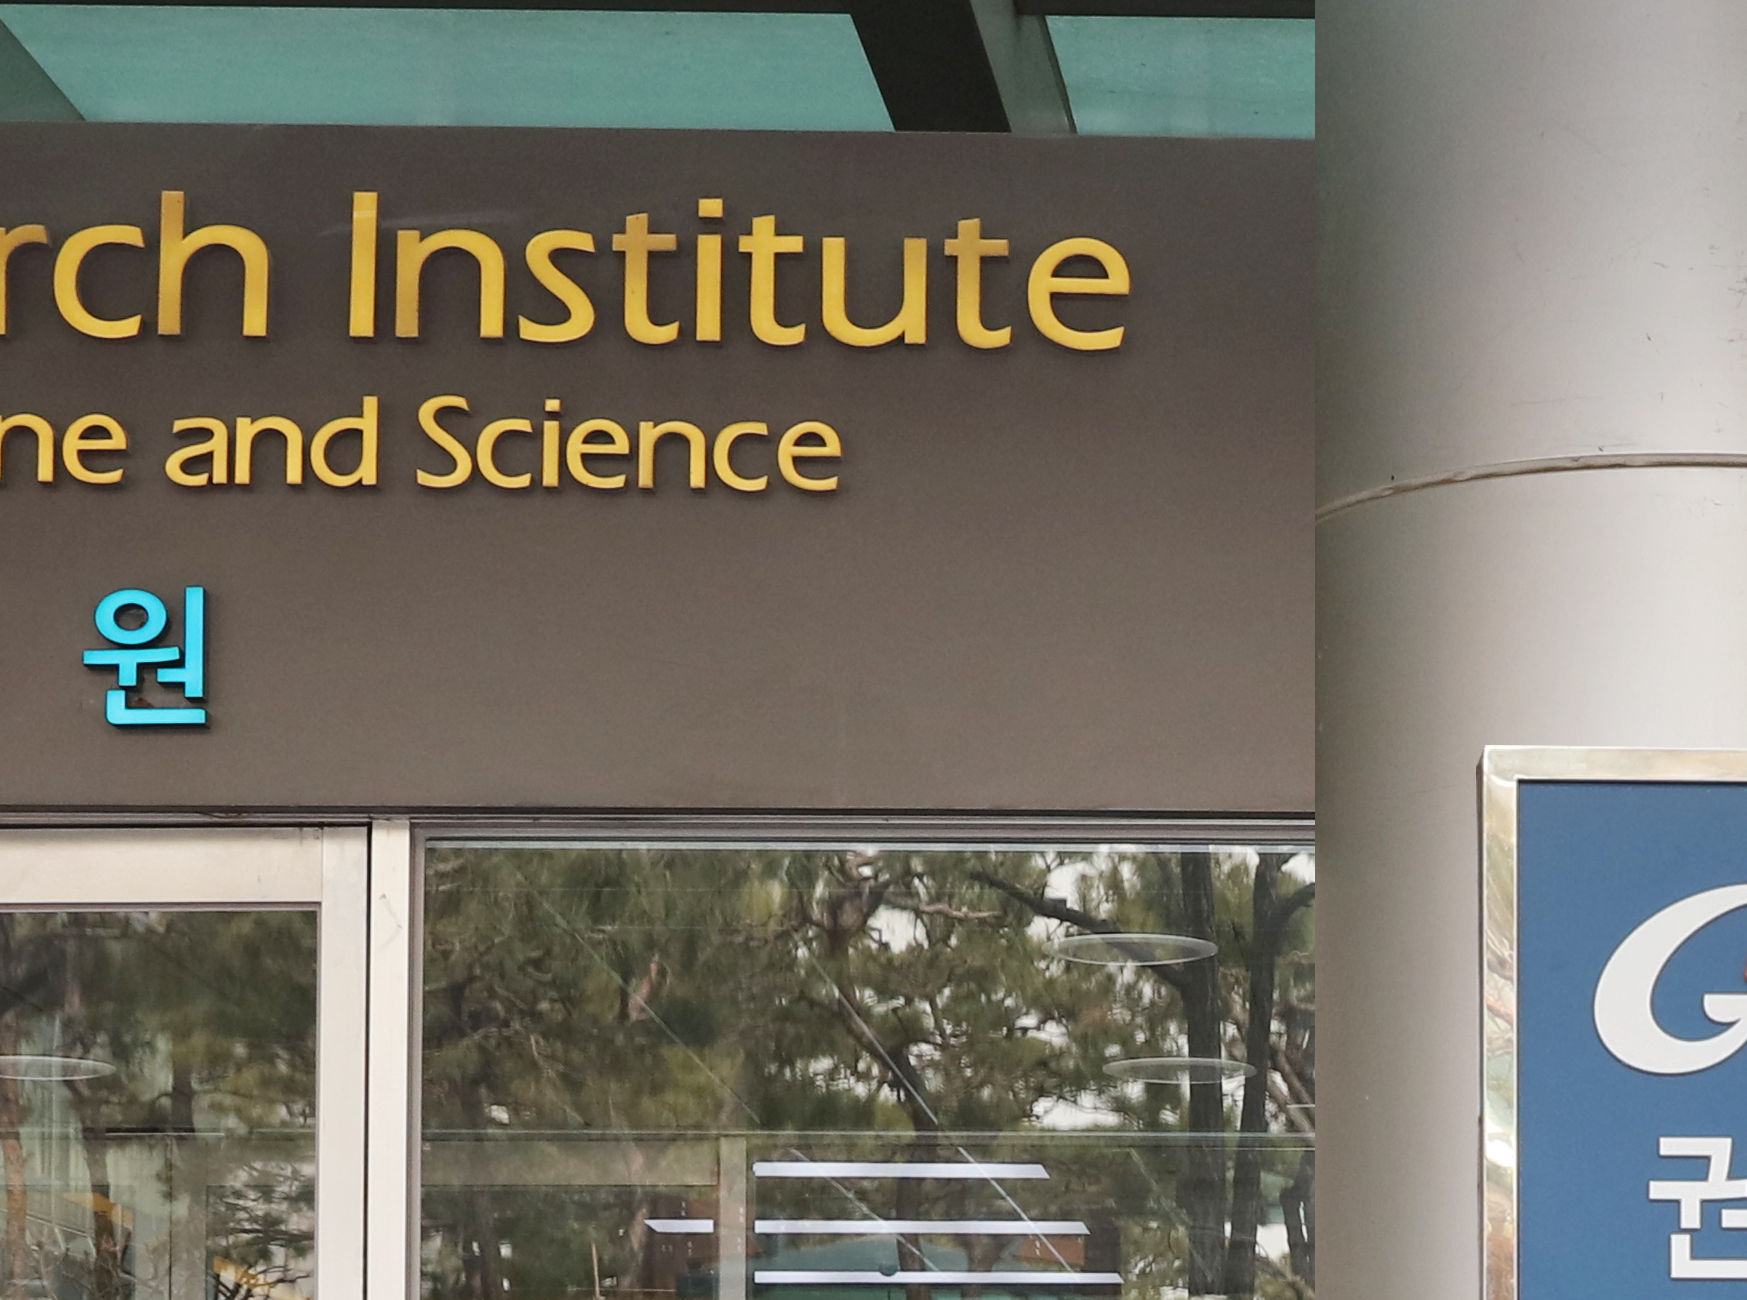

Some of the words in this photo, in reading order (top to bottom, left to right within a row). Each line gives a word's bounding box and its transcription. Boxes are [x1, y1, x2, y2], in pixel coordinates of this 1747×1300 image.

[349, 192, 1131, 350] Institute
[165, 396, 378, 487] and
[417, 396, 843, 491] Science
